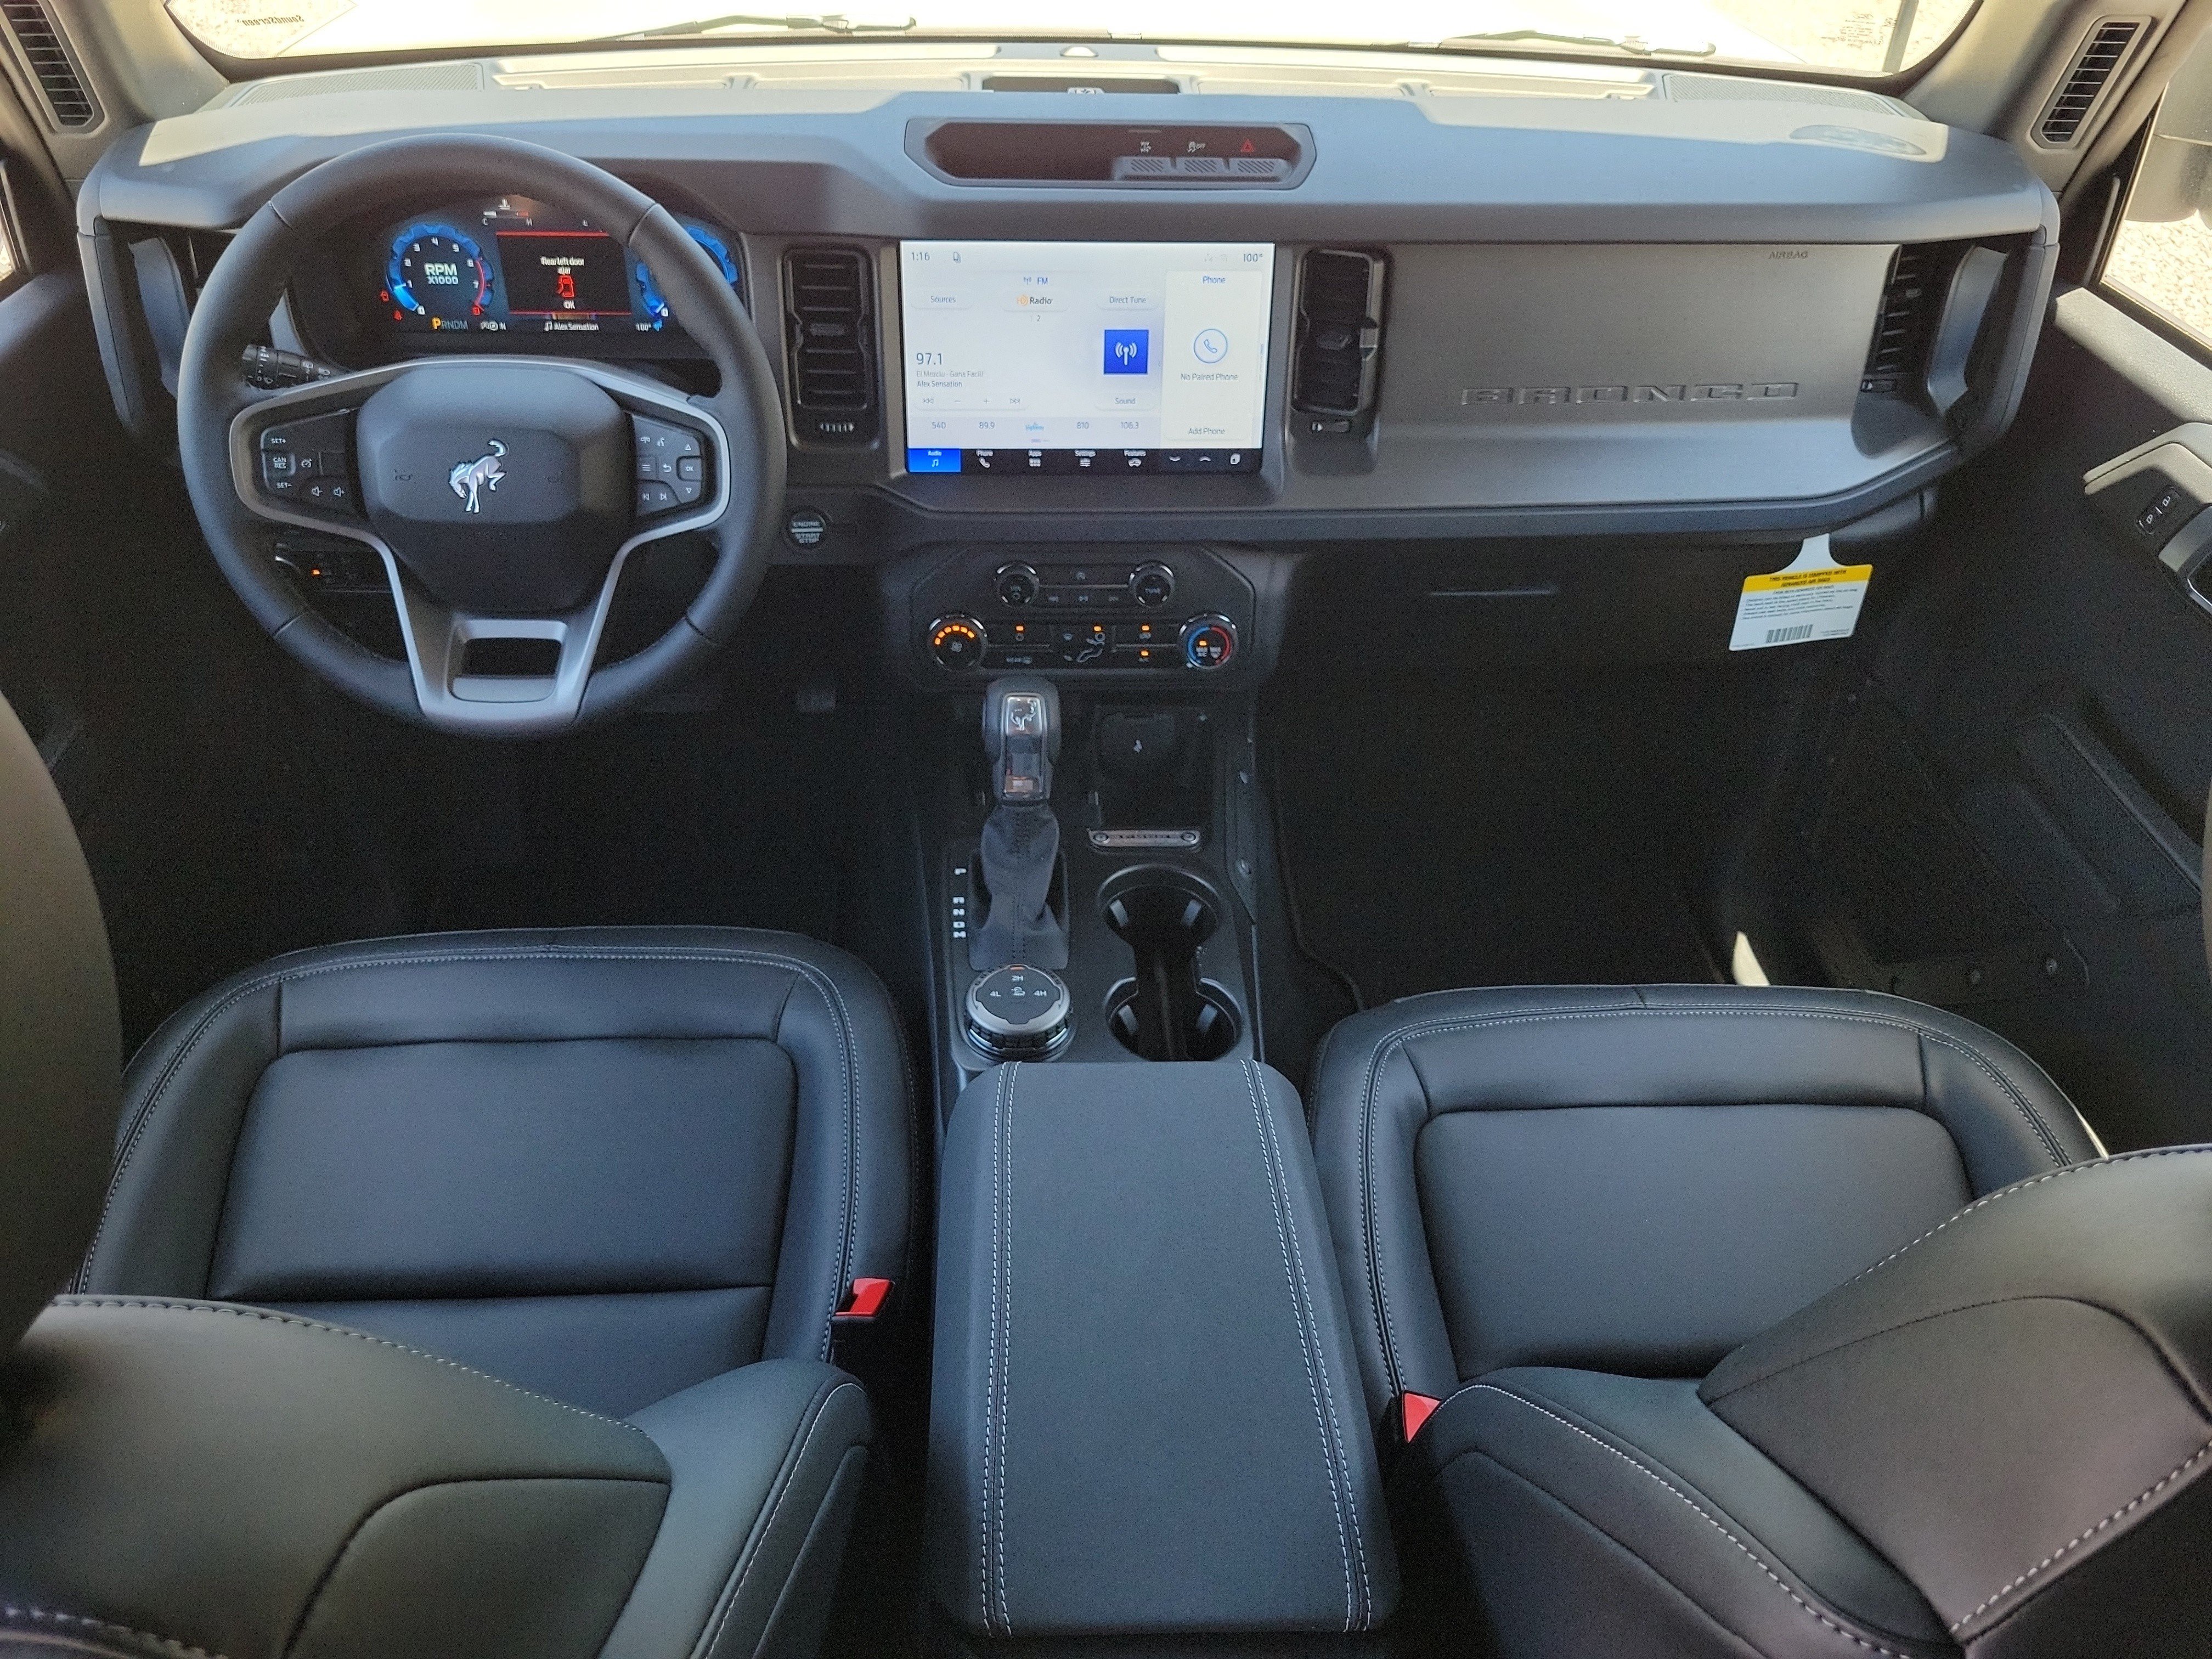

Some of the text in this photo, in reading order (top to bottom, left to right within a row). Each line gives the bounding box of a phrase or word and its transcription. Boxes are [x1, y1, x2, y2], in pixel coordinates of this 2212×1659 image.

[431, 237, 438, 246] 4
[413, 243, 420, 252] 3
[911, 252, 930, 261] 1:16
[1768, 251, 1808, 259] AIRBAG
[404, 258, 411, 267] 2
[569, 256, 585, 266] door
[425, 263, 458, 275] RPM
[407, 280, 413, 288] 1
[427, 275, 459, 285] X1000
[1202, 275, 1226, 284] Phone
[473, 280, 479, 289] 7
[1109, 296, 1146, 304] Direct Tune
[417, 305, 425, 315] 0
[916, 353, 943, 365] 97.1
[1462, 382, 1799, 405] BRONCO
